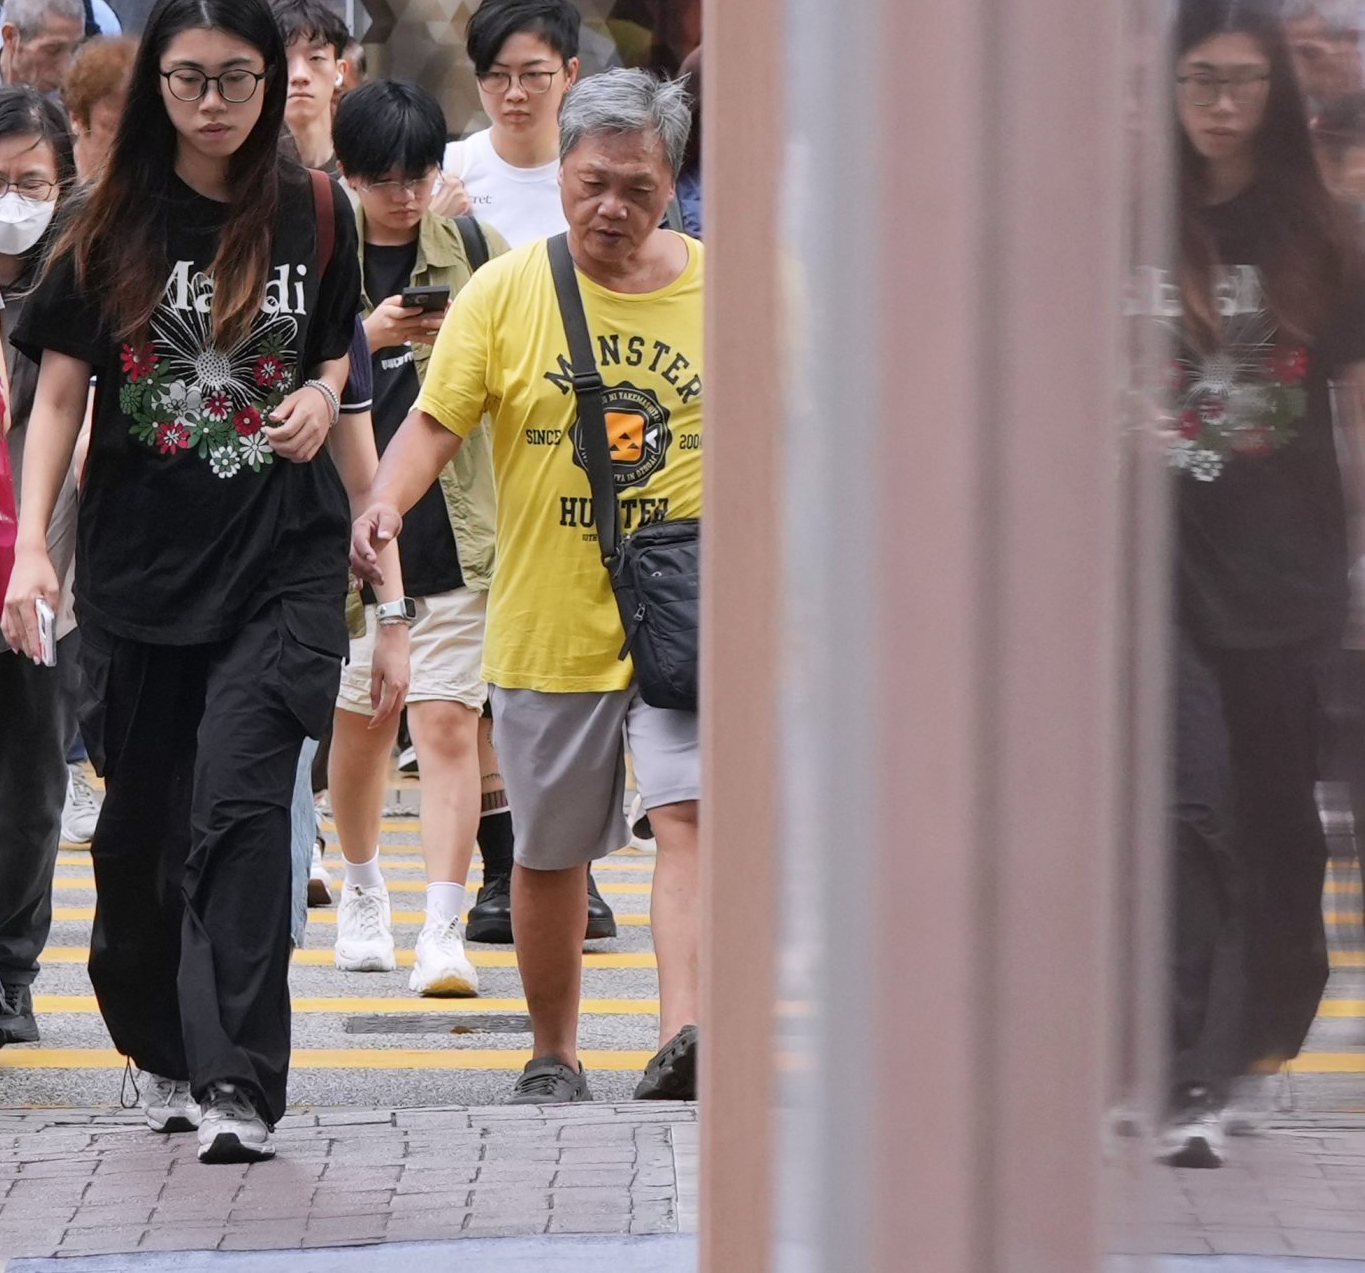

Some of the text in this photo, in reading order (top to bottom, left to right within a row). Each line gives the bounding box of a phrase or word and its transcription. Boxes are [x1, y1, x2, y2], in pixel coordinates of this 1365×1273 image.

[543, 334, 702, 404] MNSTER
[526, 429, 561, 445] SINCE
[679, 434, 702, 450] 200
[559, 496, 669, 528] HUTER
